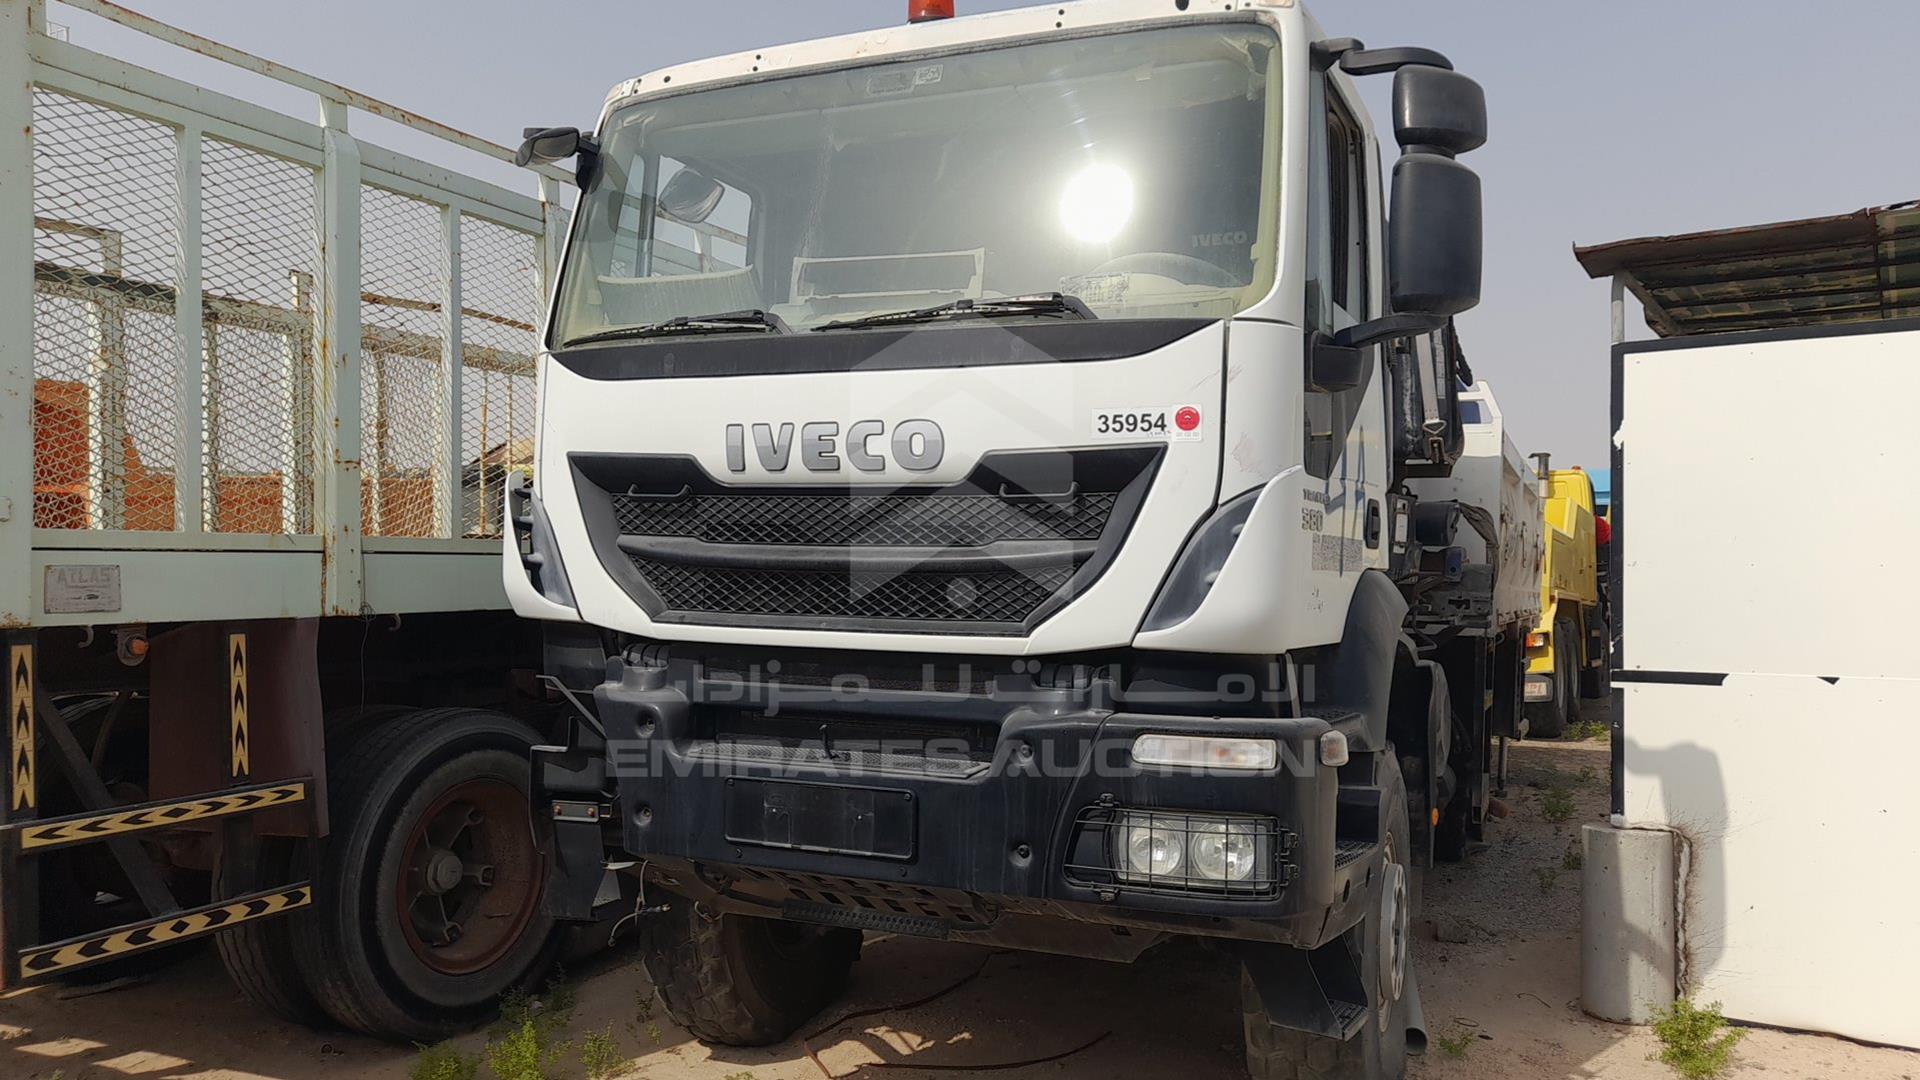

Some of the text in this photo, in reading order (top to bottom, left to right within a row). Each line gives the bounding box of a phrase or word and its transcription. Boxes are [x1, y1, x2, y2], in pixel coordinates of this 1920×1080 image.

[1191, 231, 1248, 248] IVECO
[1097, 412, 1168, 433] 35954
[725, 419, 945, 473] IVECO
